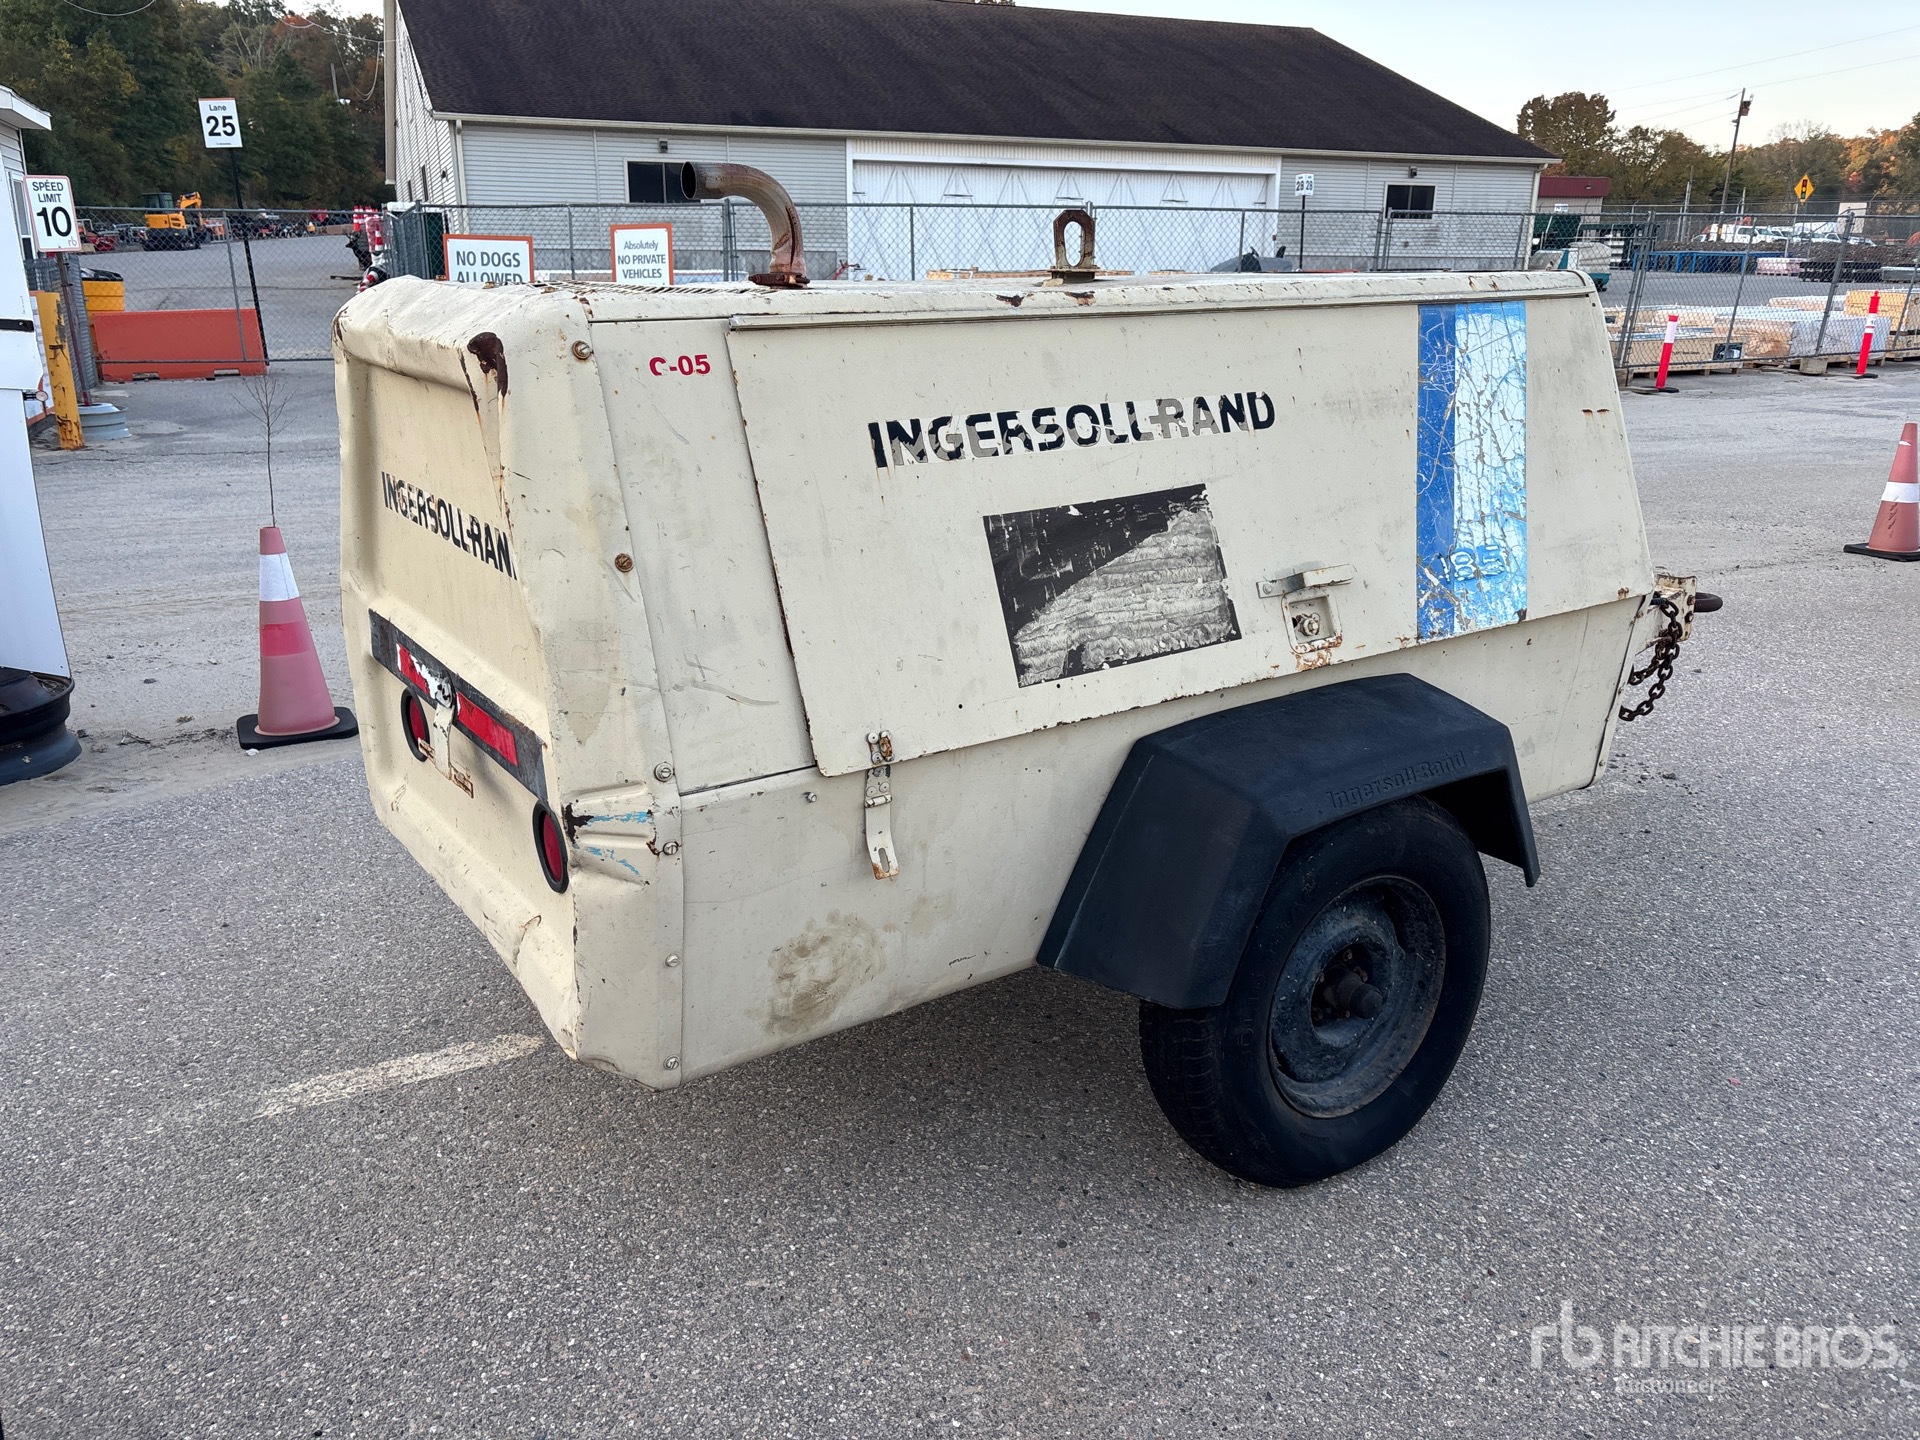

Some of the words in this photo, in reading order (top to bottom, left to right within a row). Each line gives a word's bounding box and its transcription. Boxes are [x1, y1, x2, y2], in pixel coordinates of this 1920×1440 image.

[206, 115, 236, 137] 25
[32, 181, 64, 191] SPEED
[38, 193, 62, 203] LIMIT
[36, 206, 72, 237] 10
[624, 240, 659, 251] Absolutely
[456, 251, 477, 266] NO
[480, 251, 521, 268] DOGS
[617, 254, 631, 265] NO
[632, 254, 667, 265] PRIVATE
[622, 268, 662, 279] VEHICLES
[649, 353, 711, 376] C-05
[867, 391, 1276, 468] INGERSOLL-RAND
[381, 471, 518, 580] INGERSOLL-RAN
